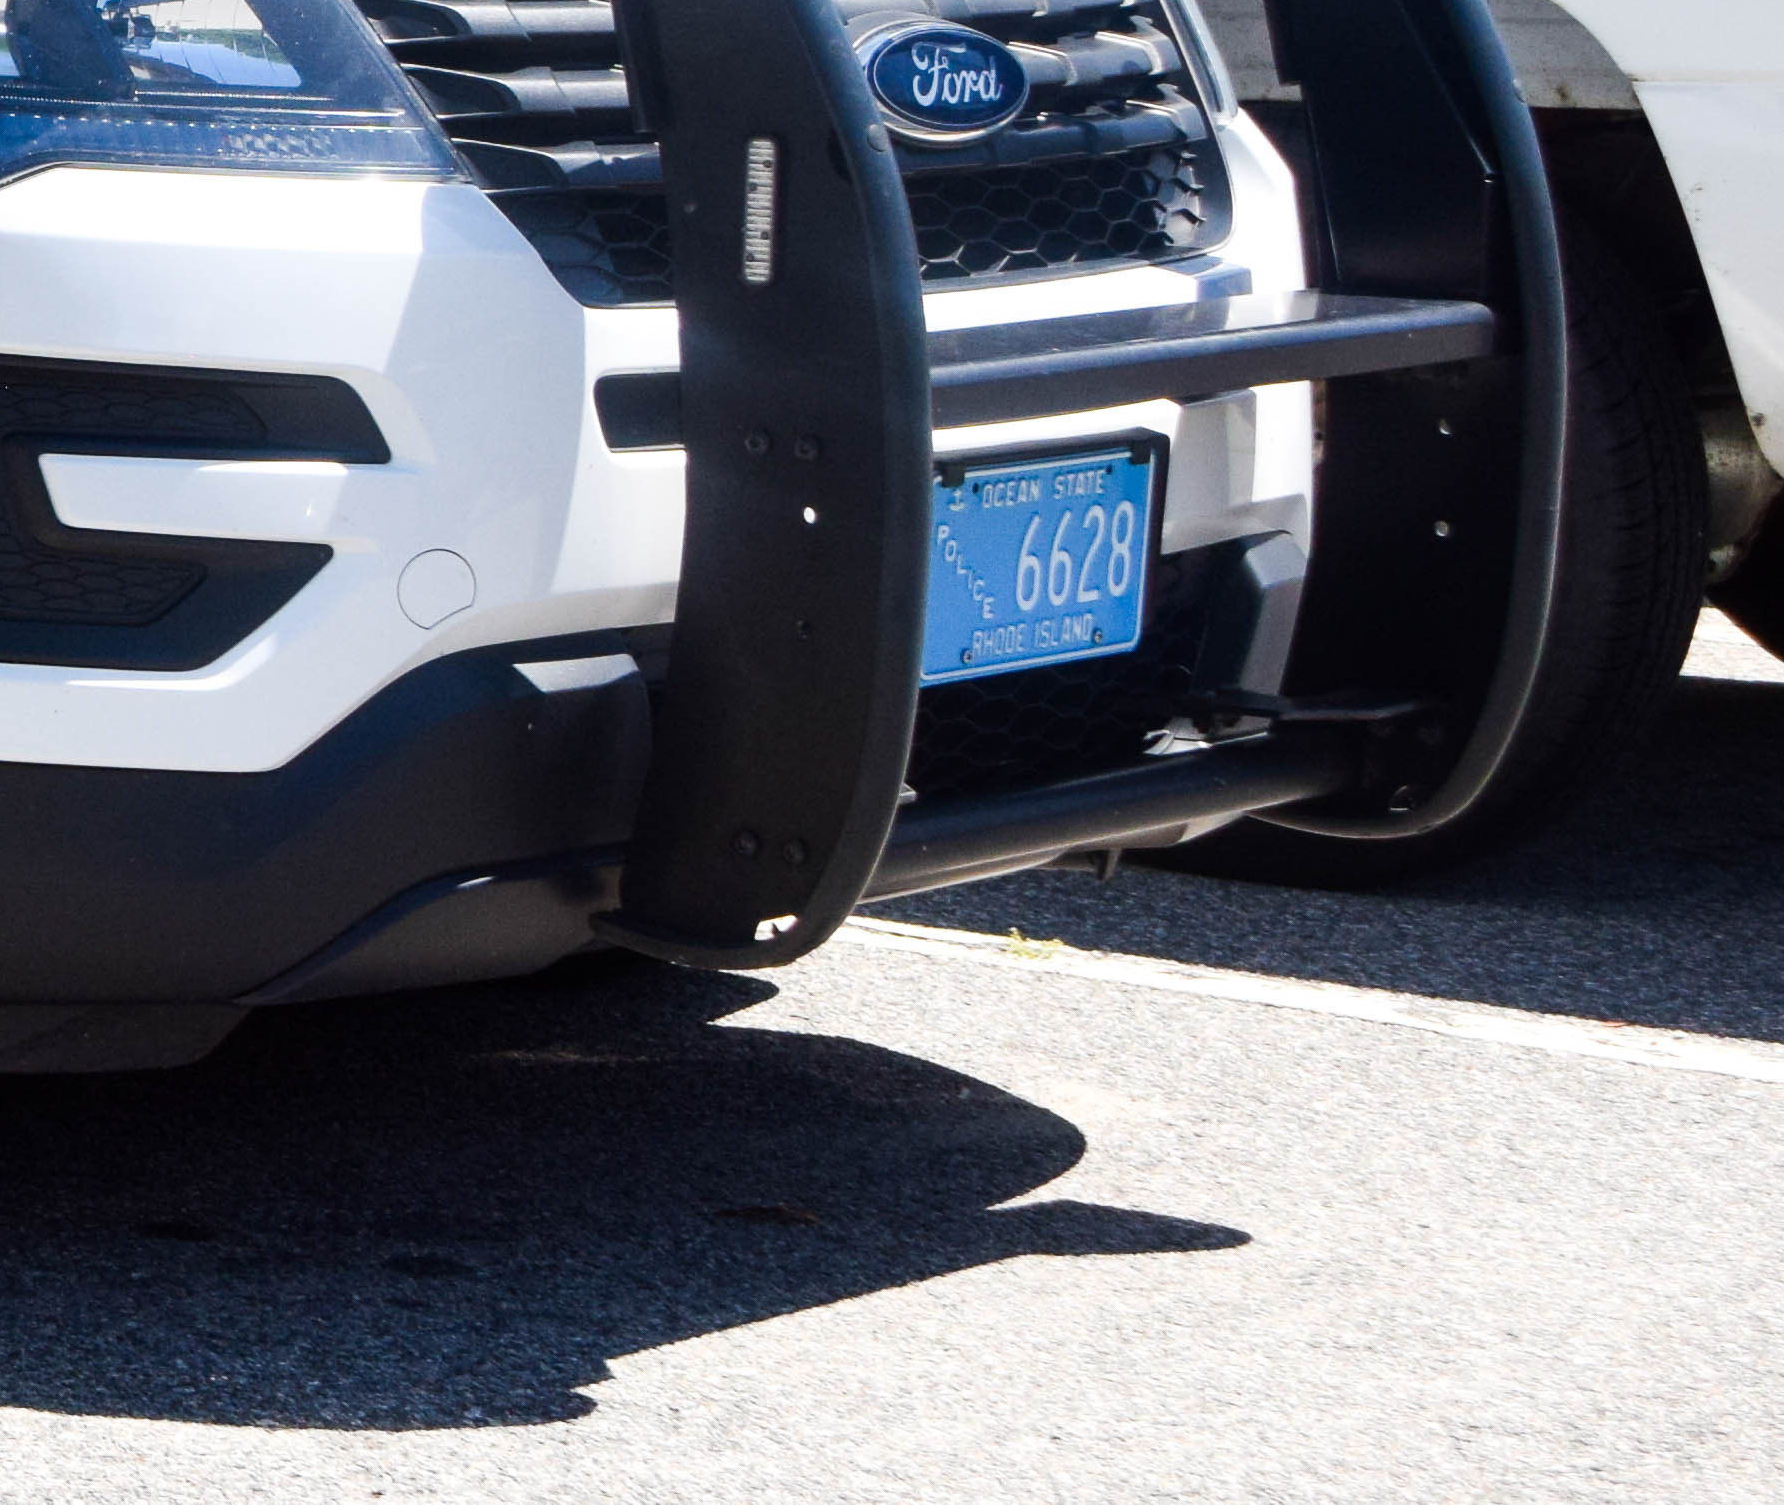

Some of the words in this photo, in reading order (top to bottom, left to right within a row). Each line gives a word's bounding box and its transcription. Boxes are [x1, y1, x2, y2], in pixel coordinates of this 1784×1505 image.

[911, 41, 1003, 107] Ford
[982, 478, 1041, 508] OCEAN
[1053, 470, 1106, 500] STATE
[937, 524, 994, 619] POLICE
[1017, 501, 1134, 611] 6628
[971, 623, 1027, 657] RHODE
[1034, 613, 1094, 648] ISLAND
